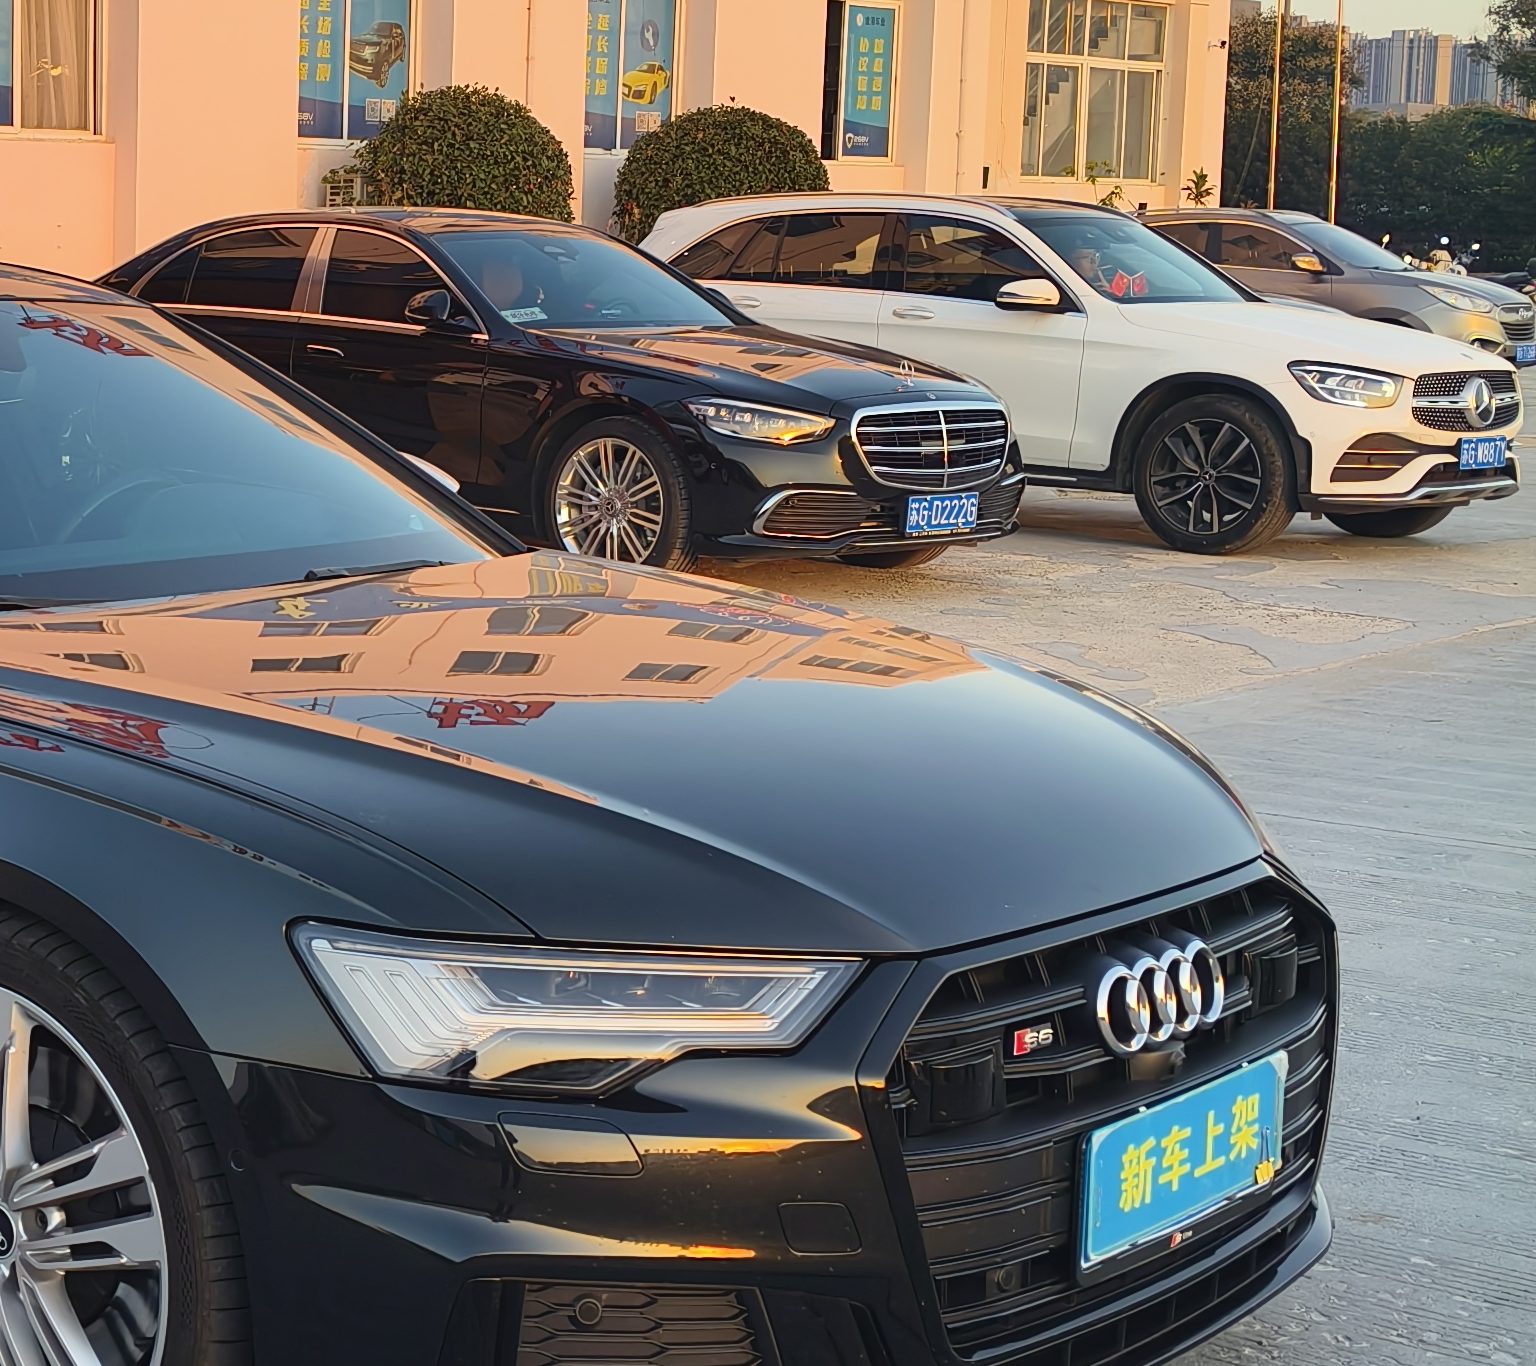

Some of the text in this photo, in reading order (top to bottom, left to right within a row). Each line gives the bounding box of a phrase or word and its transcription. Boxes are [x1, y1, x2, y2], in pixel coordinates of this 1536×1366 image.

[1024, 1028, 1054, 1049] S6
[1118, 1092, 1260, 1213] 新车上架
